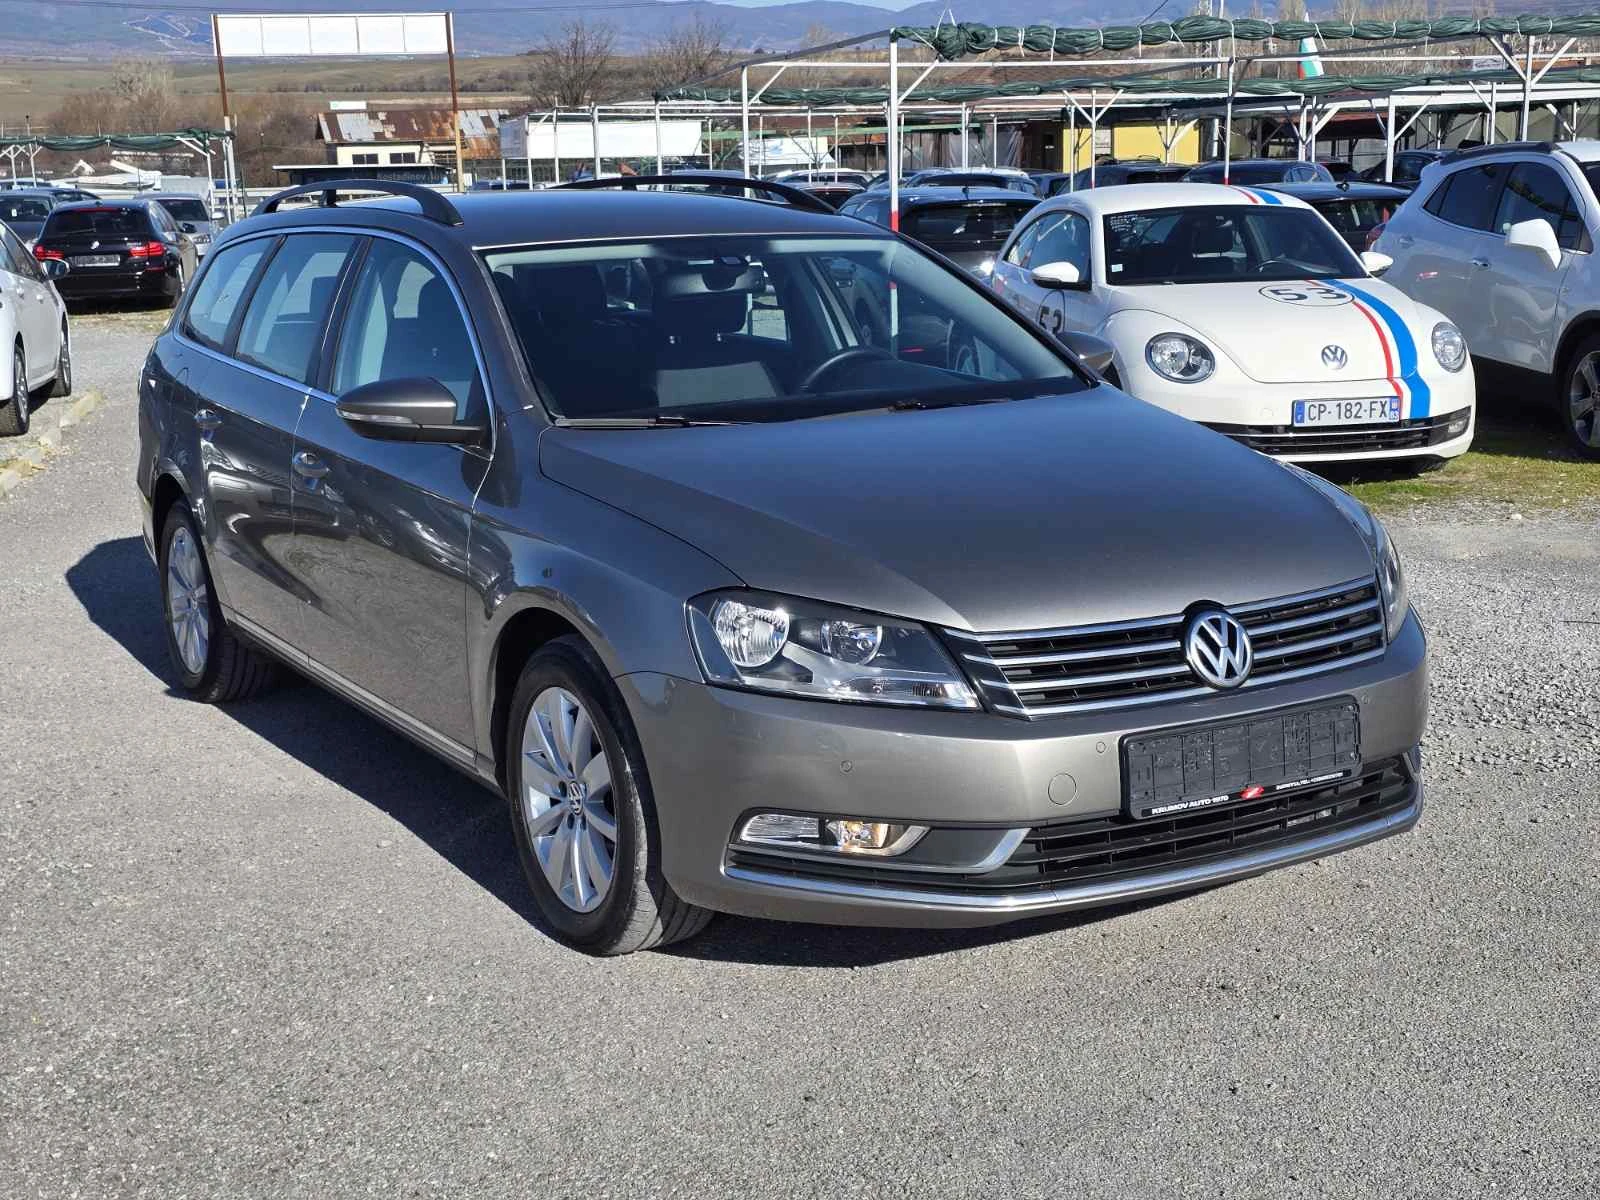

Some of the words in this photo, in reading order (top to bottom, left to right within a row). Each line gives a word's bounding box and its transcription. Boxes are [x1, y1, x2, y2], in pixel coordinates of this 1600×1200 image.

[1267, 287, 1347, 301] 53
[1321, 345, 1348, 370] VW
[1308, 400, 1388, 421] CP-182-FX
[1187, 611, 1252, 688] VW
[1189, 798, 1211, 808] AUTO
